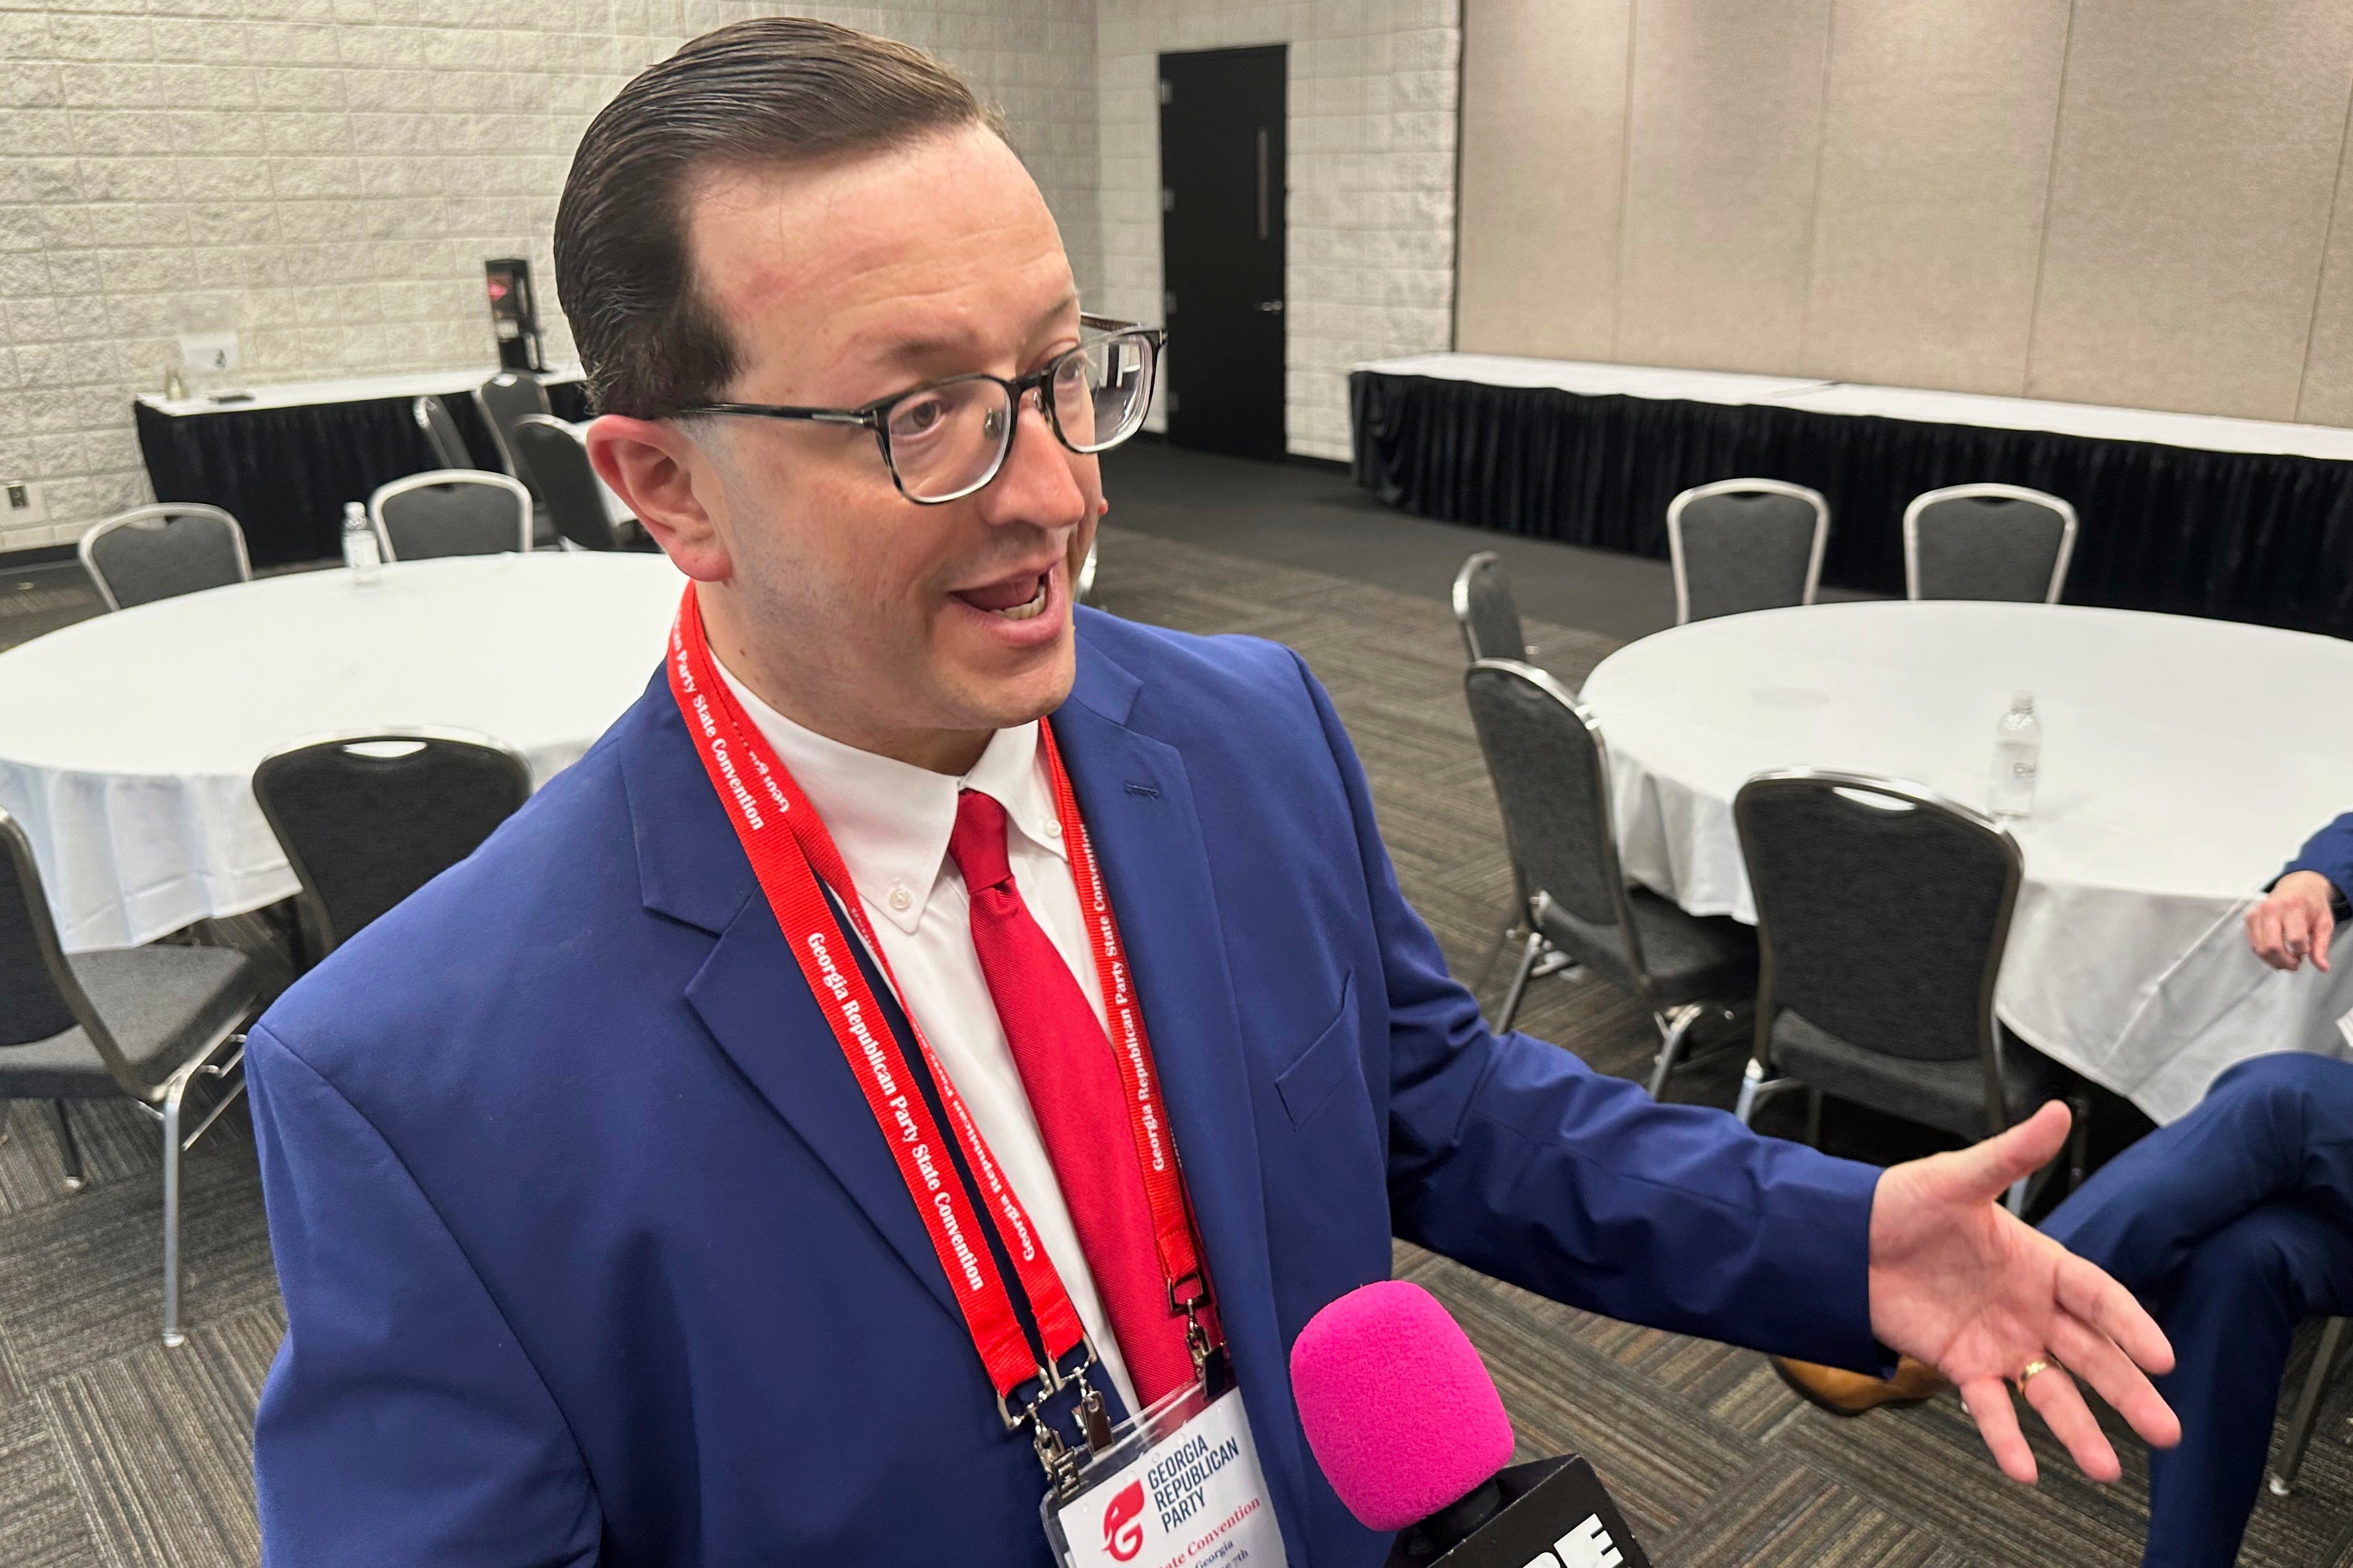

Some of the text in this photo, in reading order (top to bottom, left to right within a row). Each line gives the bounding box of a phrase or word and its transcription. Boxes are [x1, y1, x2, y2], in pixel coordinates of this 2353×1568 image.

[676, 650, 696, 693] Party
[693, 694, 717, 738] State
[711, 738, 764, 830] Convention
[1100, 916, 1117, 957] State
[1112, 961, 1128, 1005] Party
[1121, 1008, 1149, 1101] Republican
[808, 932, 848, 1000] Georgia
[842, 1000, 896, 1095] Republican
[889, 1095, 918, 1142] Party
[912, 1144, 941, 1191] State
[934, 1192, 983, 1291] Convention
[1142, 1104, 1164, 1171] Georgia
[953, 1100, 1002, 1193] Republican
[1001, 1194, 1035, 1261] Georgia
[1148, 1434, 1208, 1489] GEORGIA
[1154, 1436, 1239, 1512] REPUBLICAN
[1161, 1486, 1205, 1533] PARTY
[1187, 1498, 1260, 1556] Convention
[1195, 1540, 1234, 1568] Georgia
